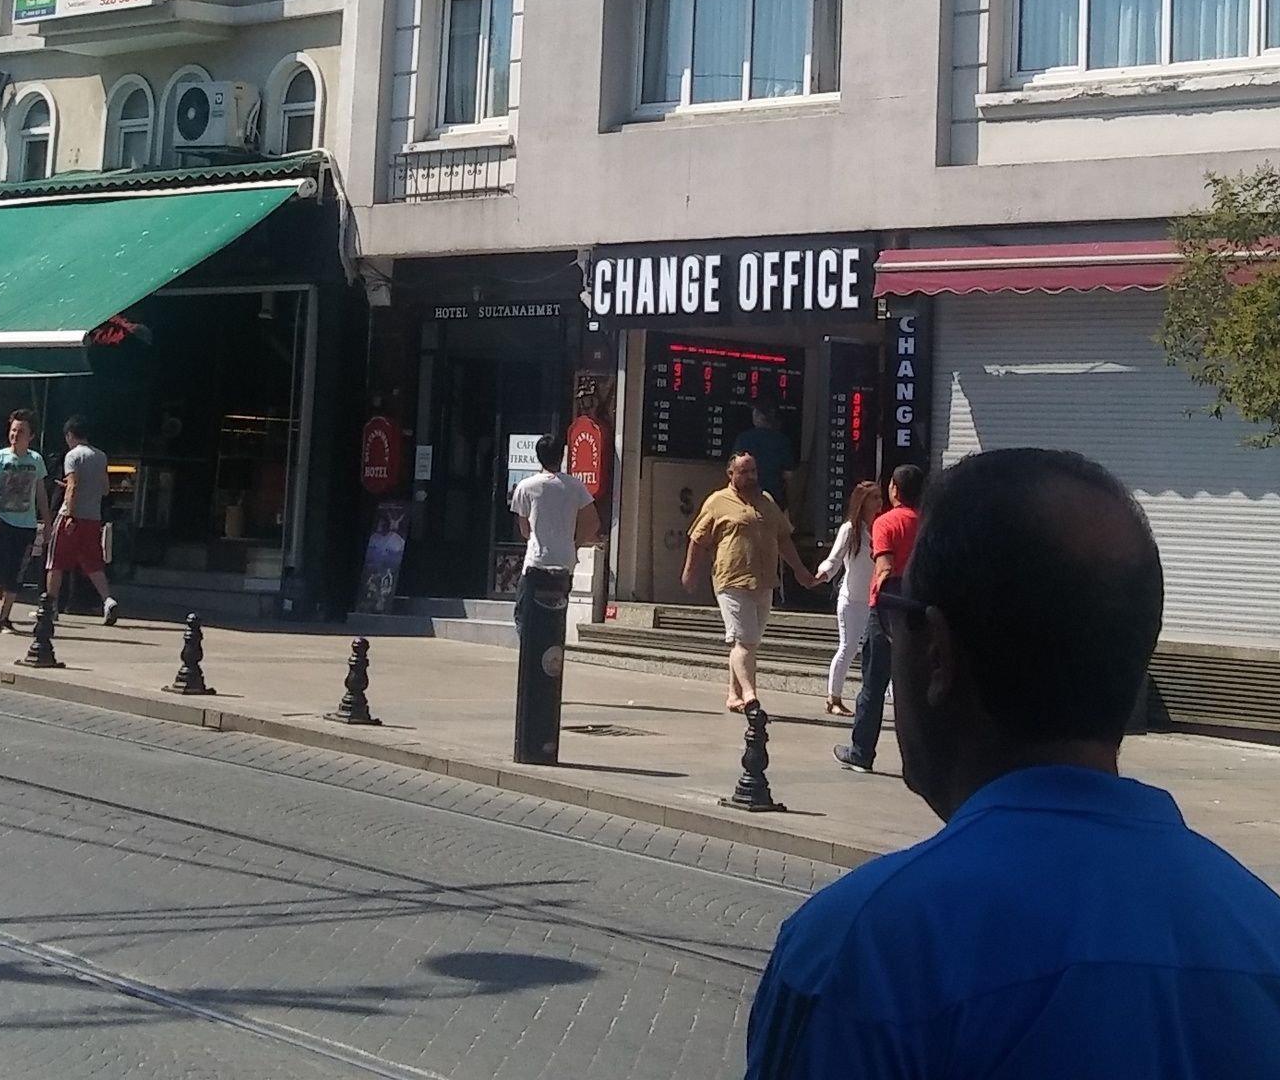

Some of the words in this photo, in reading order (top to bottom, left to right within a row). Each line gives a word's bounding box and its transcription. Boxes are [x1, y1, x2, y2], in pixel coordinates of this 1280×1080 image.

[593, 254, 721, 316] CHANGE
[738, 247, 861, 312] OFFICE
[435, 307, 468, 318] HOTEL
[478, 304, 560, 318] SULTANAHMET
[896, 316, 915, 446] CHANGE
[510, 455, 535, 463] TERRAC
